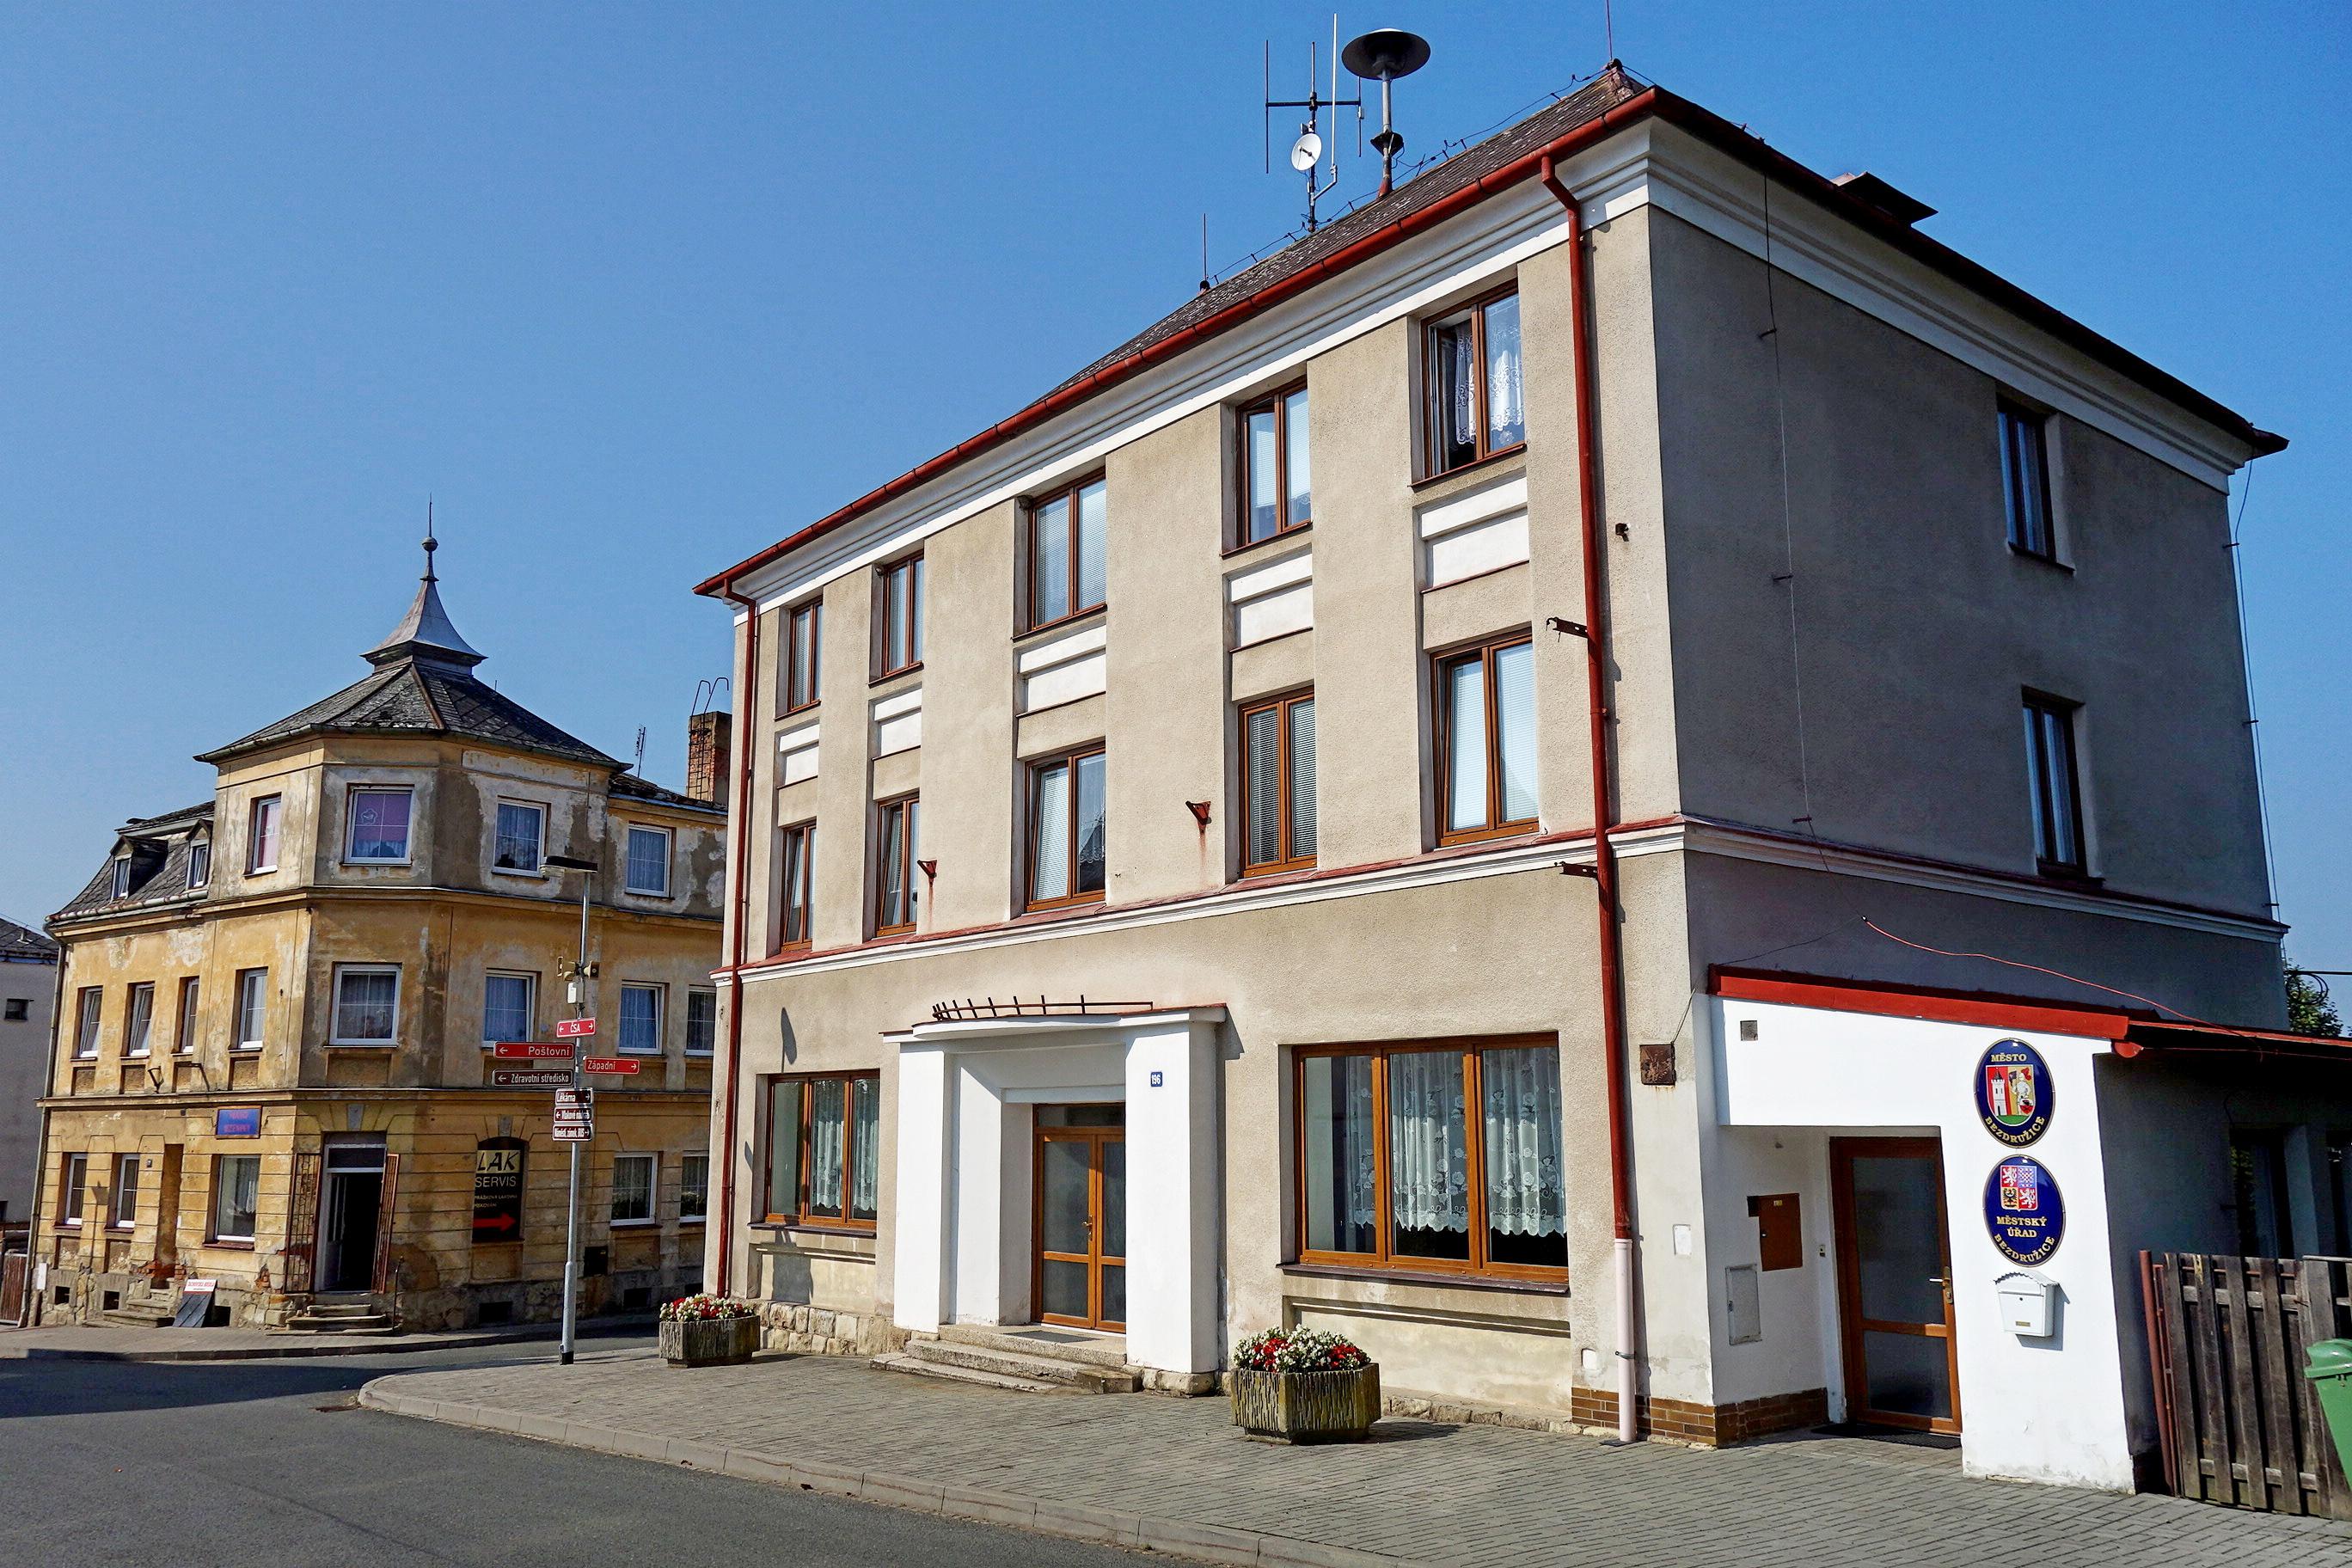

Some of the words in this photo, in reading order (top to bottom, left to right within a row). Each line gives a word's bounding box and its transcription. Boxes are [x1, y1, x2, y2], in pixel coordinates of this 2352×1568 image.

[570, 1024, 581, 1033] ČSA
[528, 1045, 570, 1056] Poštovní
[1991, 1052, 2027, 1062] MĚSTO
[587, 1060, 616, 1071] Západní
[511, 1074, 540, 1083] Zdravotní
[541, 1074, 569, 1083] středisko
[1985, 1115, 2045, 1144] BEZDRUŽICE
[477, 1151, 519, 1172] LAK
[475, 1175, 517, 1188] SERVIS
[1996, 1215, 2048, 1227] MĚSTSKÝ
[2006, 1225, 2038, 1238] ÚŘAD
[1994, 1233, 2055, 1263] BEZDRUŽICE
